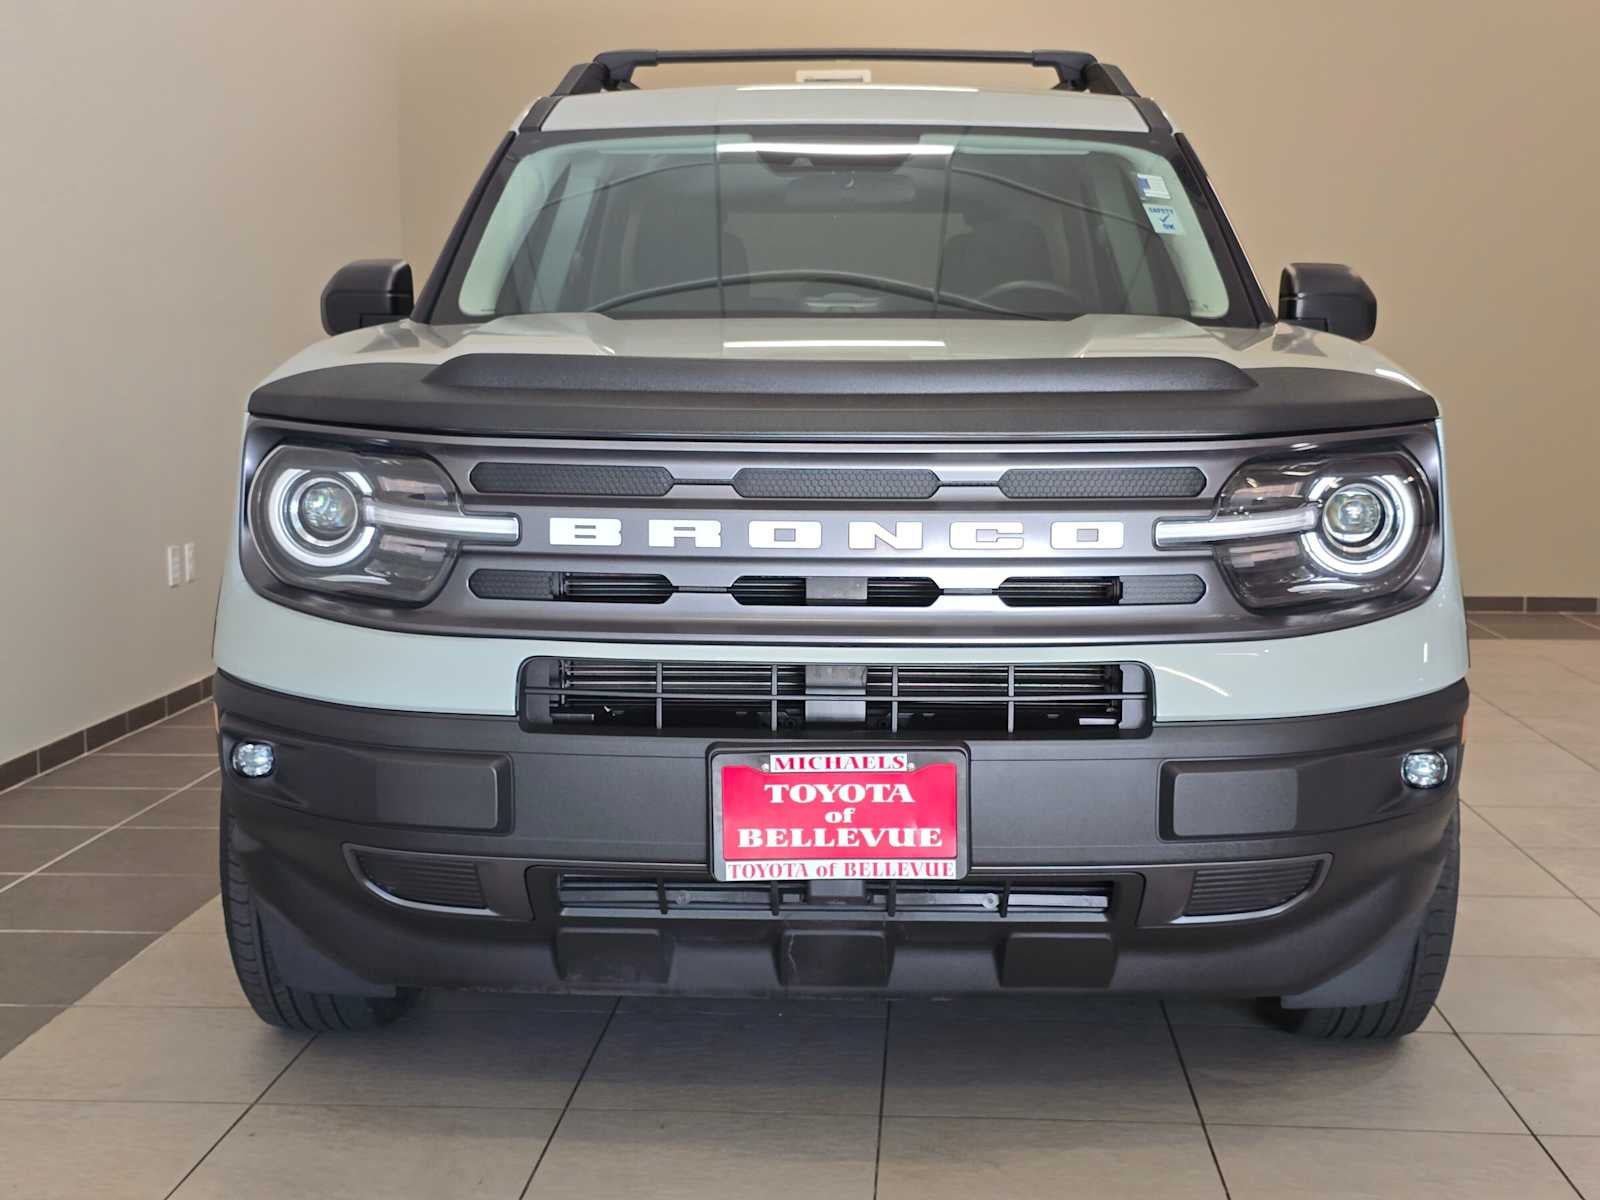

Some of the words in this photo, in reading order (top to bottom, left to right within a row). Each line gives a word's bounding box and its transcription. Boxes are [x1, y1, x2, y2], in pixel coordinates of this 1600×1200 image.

[549, 518, 1124, 550] BRONCO
[774, 755, 905, 770] MICHAELS
[764, 783, 916, 804] TOYOTA
[824, 808, 856, 824] of
[737, 828, 943, 848] BELLEVUE
[728, 863, 809, 879] TOYOTA
[816, 862, 836, 877] of
[843, 861, 954, 878] BELLEVUE
